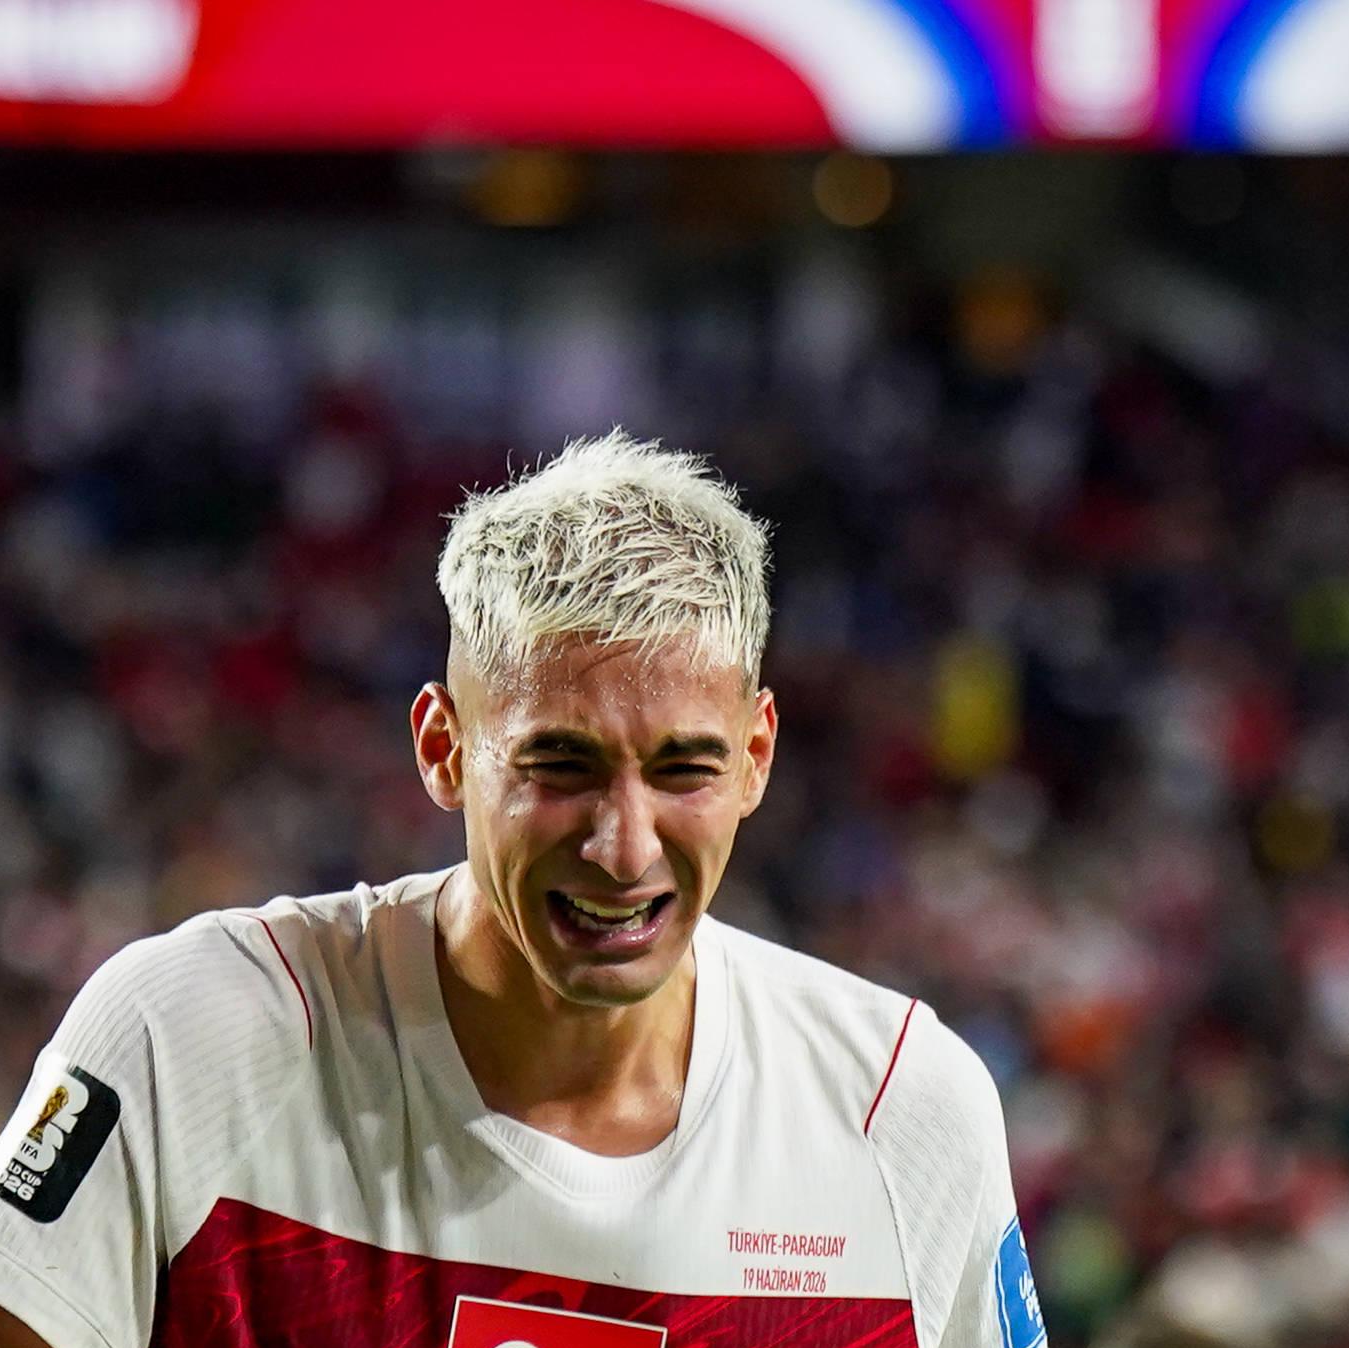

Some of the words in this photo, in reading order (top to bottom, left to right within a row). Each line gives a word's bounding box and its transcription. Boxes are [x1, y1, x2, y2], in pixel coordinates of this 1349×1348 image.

[21, 1170, 42, 1187] CUP
[743, 1267, 754, 1290] 19
[756, 1265, 801, 1292] HAZİRAN
[803, 1270, 827, 1293] 2026
